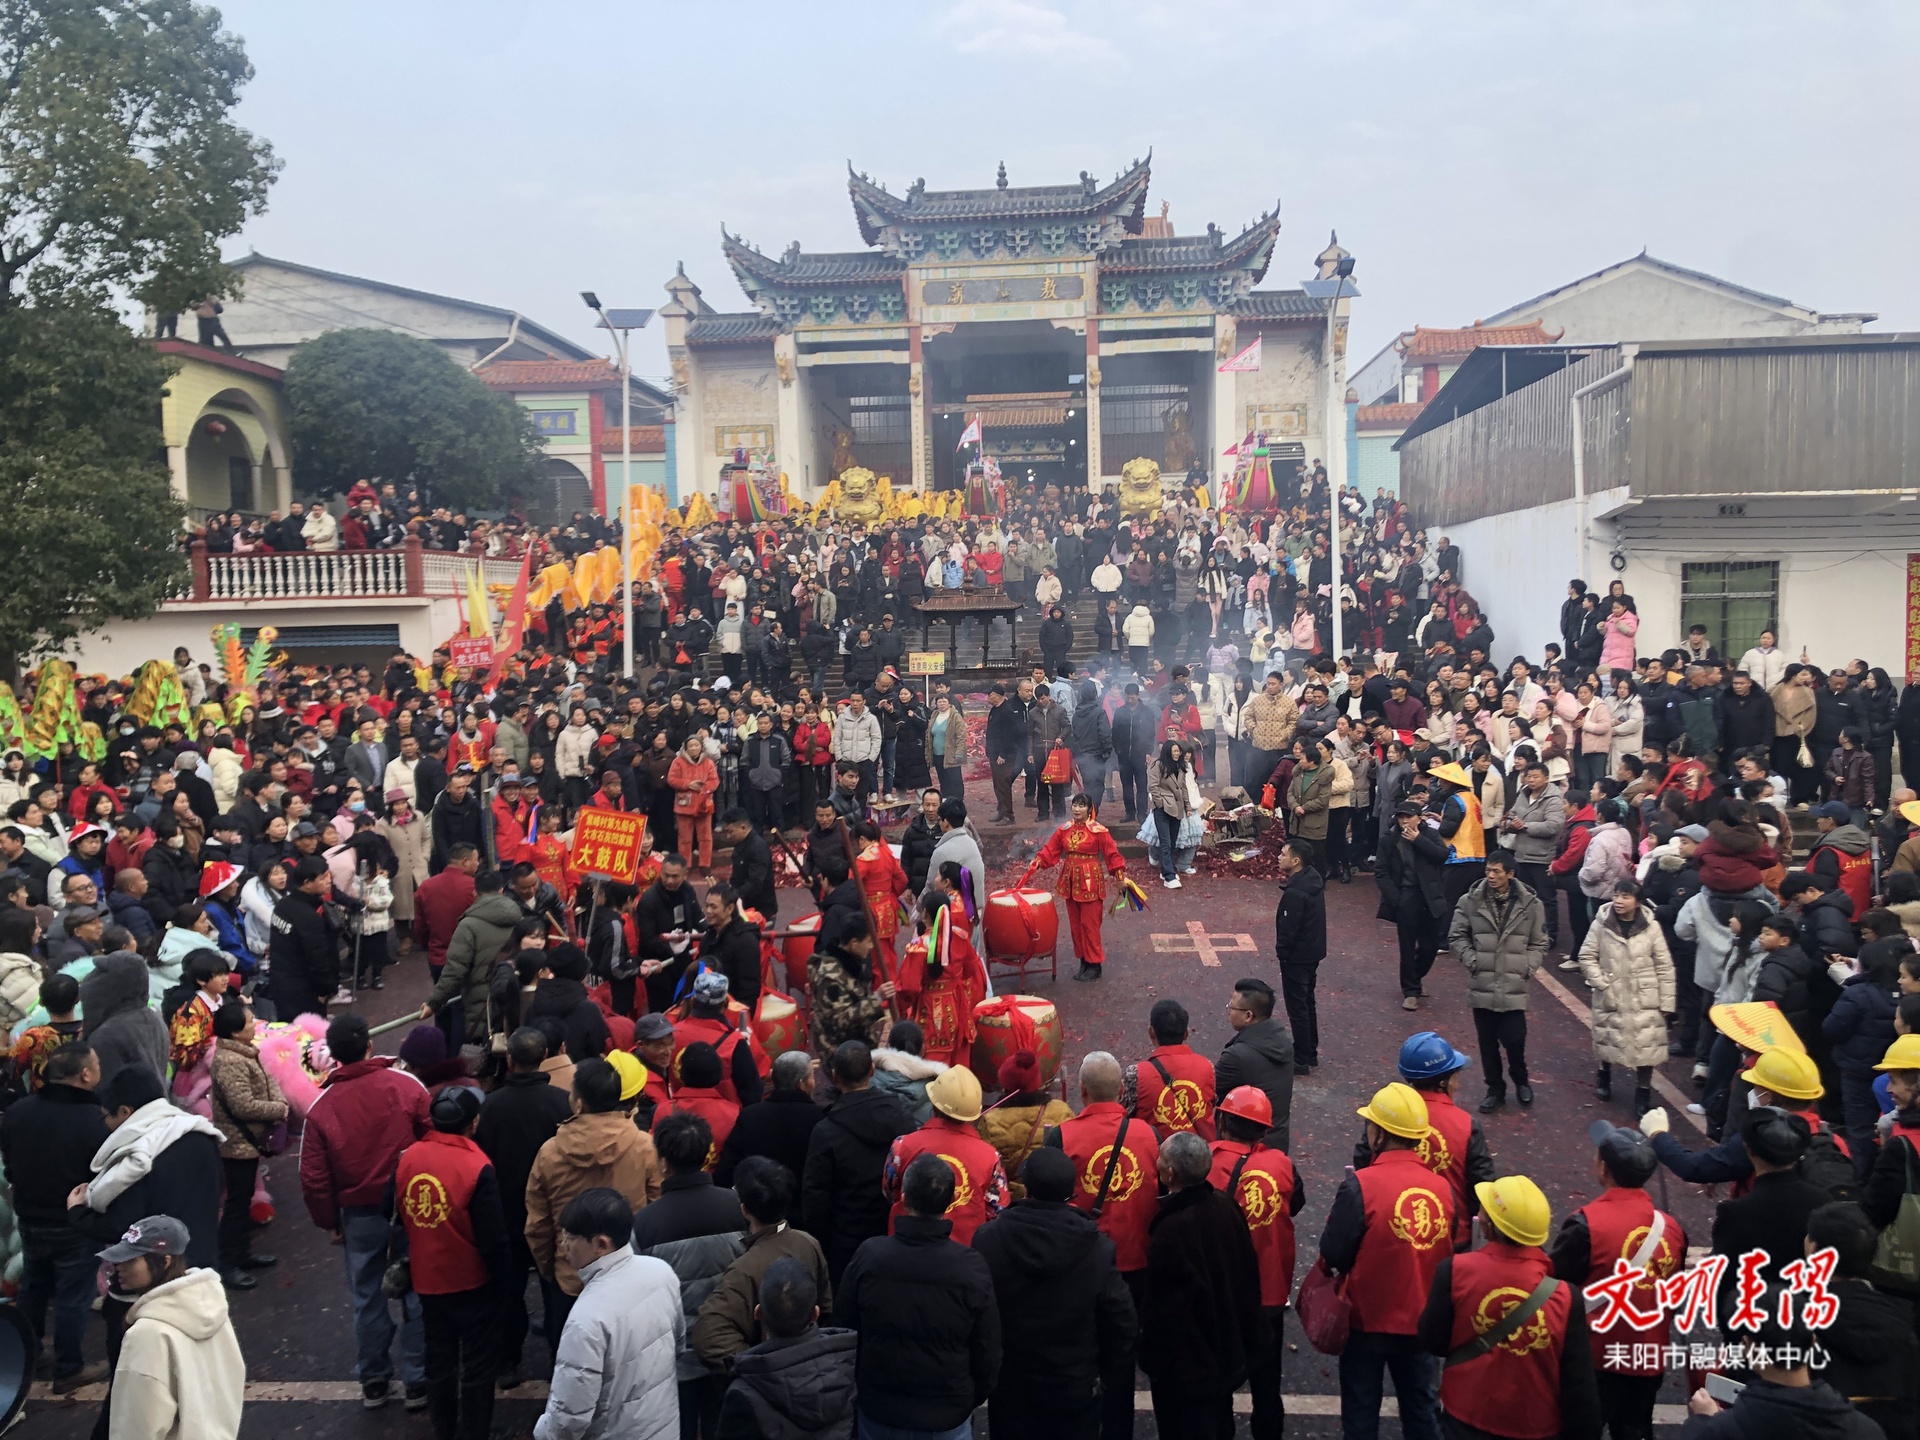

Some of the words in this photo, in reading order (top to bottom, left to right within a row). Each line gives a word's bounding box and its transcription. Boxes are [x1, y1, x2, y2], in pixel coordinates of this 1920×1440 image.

[911, 661, 945, 671] 注意用火安全
[577, 843, 628, 873] 大鼓队
[1173, 1088, 1190, 1120] 勇
[416, 1184, 432, 1218] 勇
[1243, 1180, 1267, 1219] 勇
[1411, 1198, 1431, 1239] 勇
